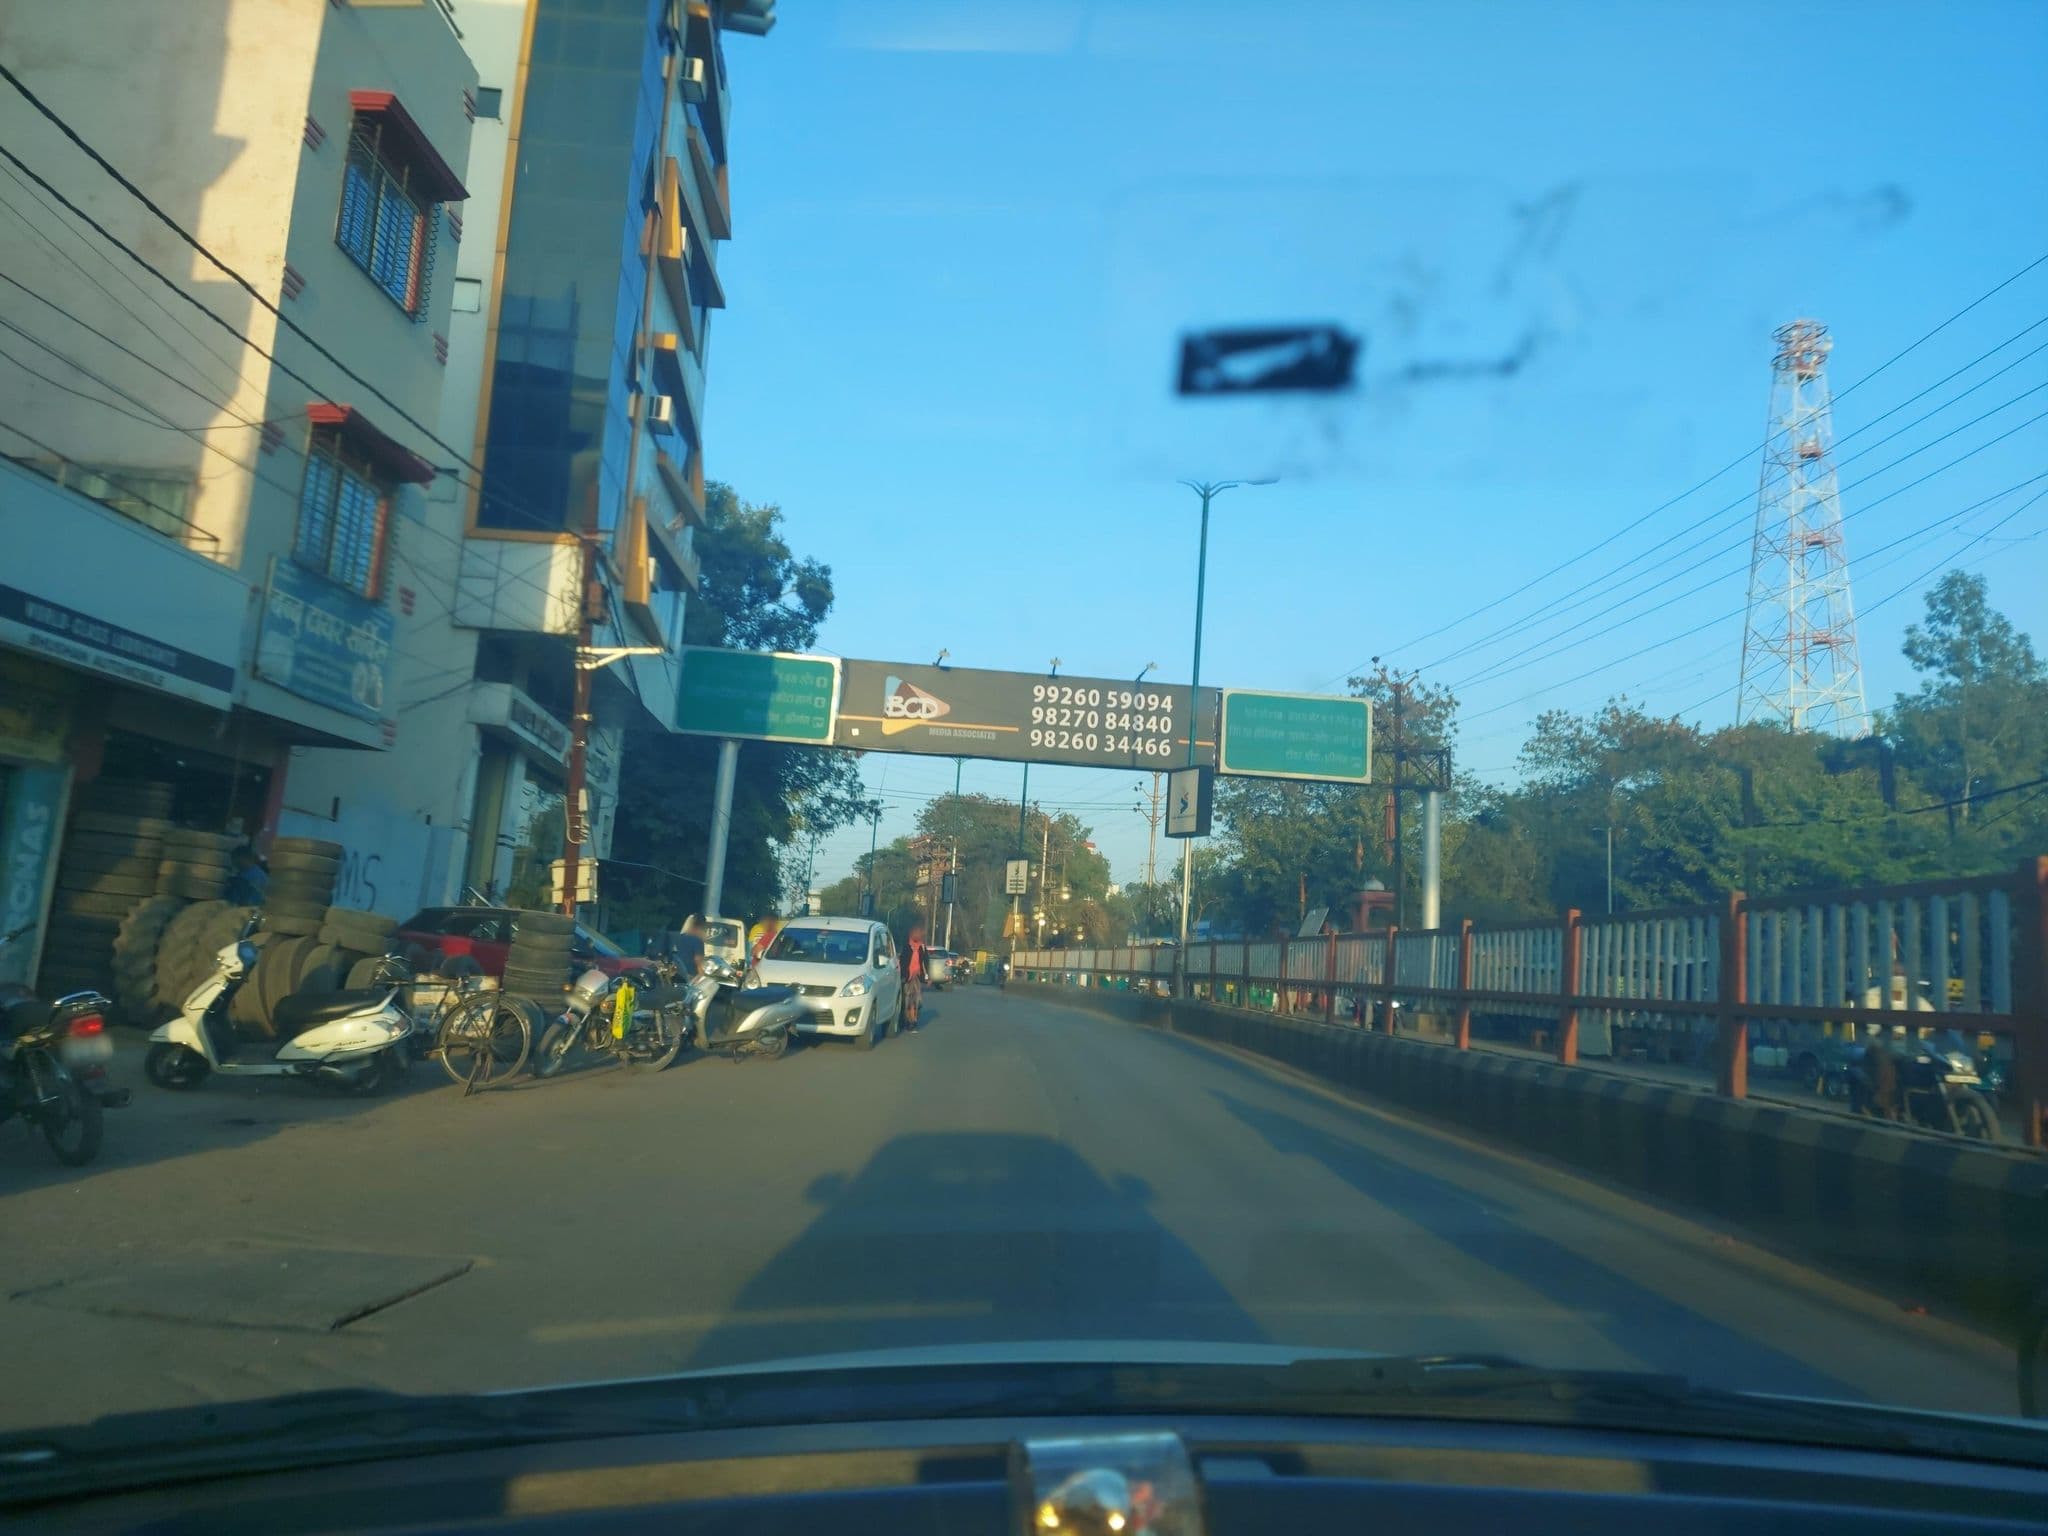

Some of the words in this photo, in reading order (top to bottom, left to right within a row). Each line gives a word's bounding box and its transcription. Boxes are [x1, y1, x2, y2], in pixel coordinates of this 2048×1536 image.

[884, 695, 939, 719] BCD
[1032, 685, 1100, 707] 99260
[1106, 691, 1173, 713] 59094
[928, 727, 951, 737] MEDIA
[953, 729, 996, 740] ASSOCIATES
[1031, 706, 1099, 729] 98270
[1105, 712, 1172, 734] 84840
[1030, 729, 1098, 751] 98260
[1104, 735, 1171, 756] 34466
